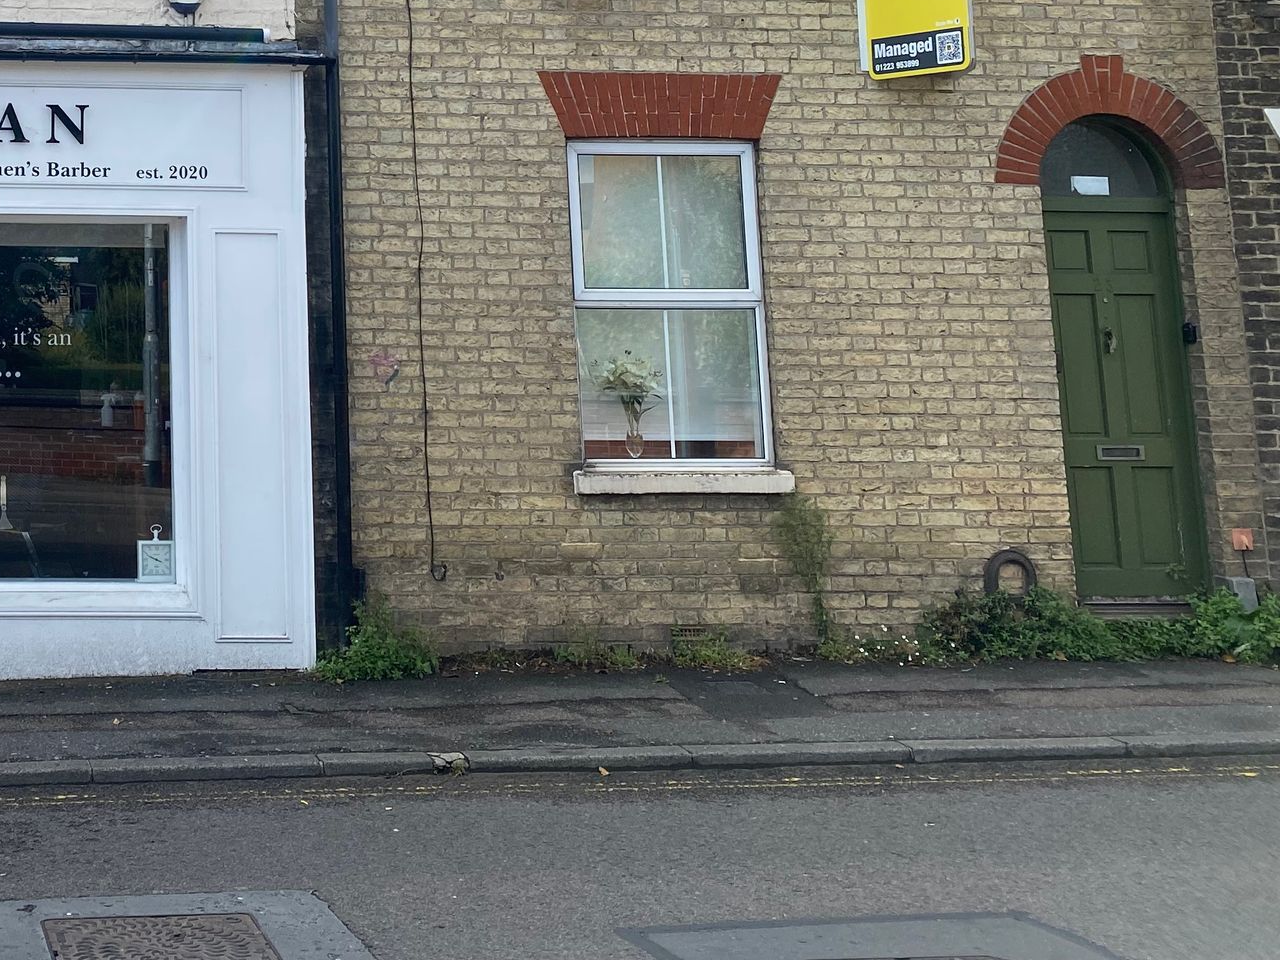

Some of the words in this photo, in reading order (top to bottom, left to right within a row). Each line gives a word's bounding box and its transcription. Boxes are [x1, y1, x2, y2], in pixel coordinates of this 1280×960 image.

[873, 37, 933, 59] Managed
[875, 63, 895, 71] 01223
[46, 161, 111, 178] Barber
[136, 166, 163, 179] est.
[169, 165, 208, 180] 2020
[13, 326, 42, 346] it's
[47, 332, 73, 346] an
